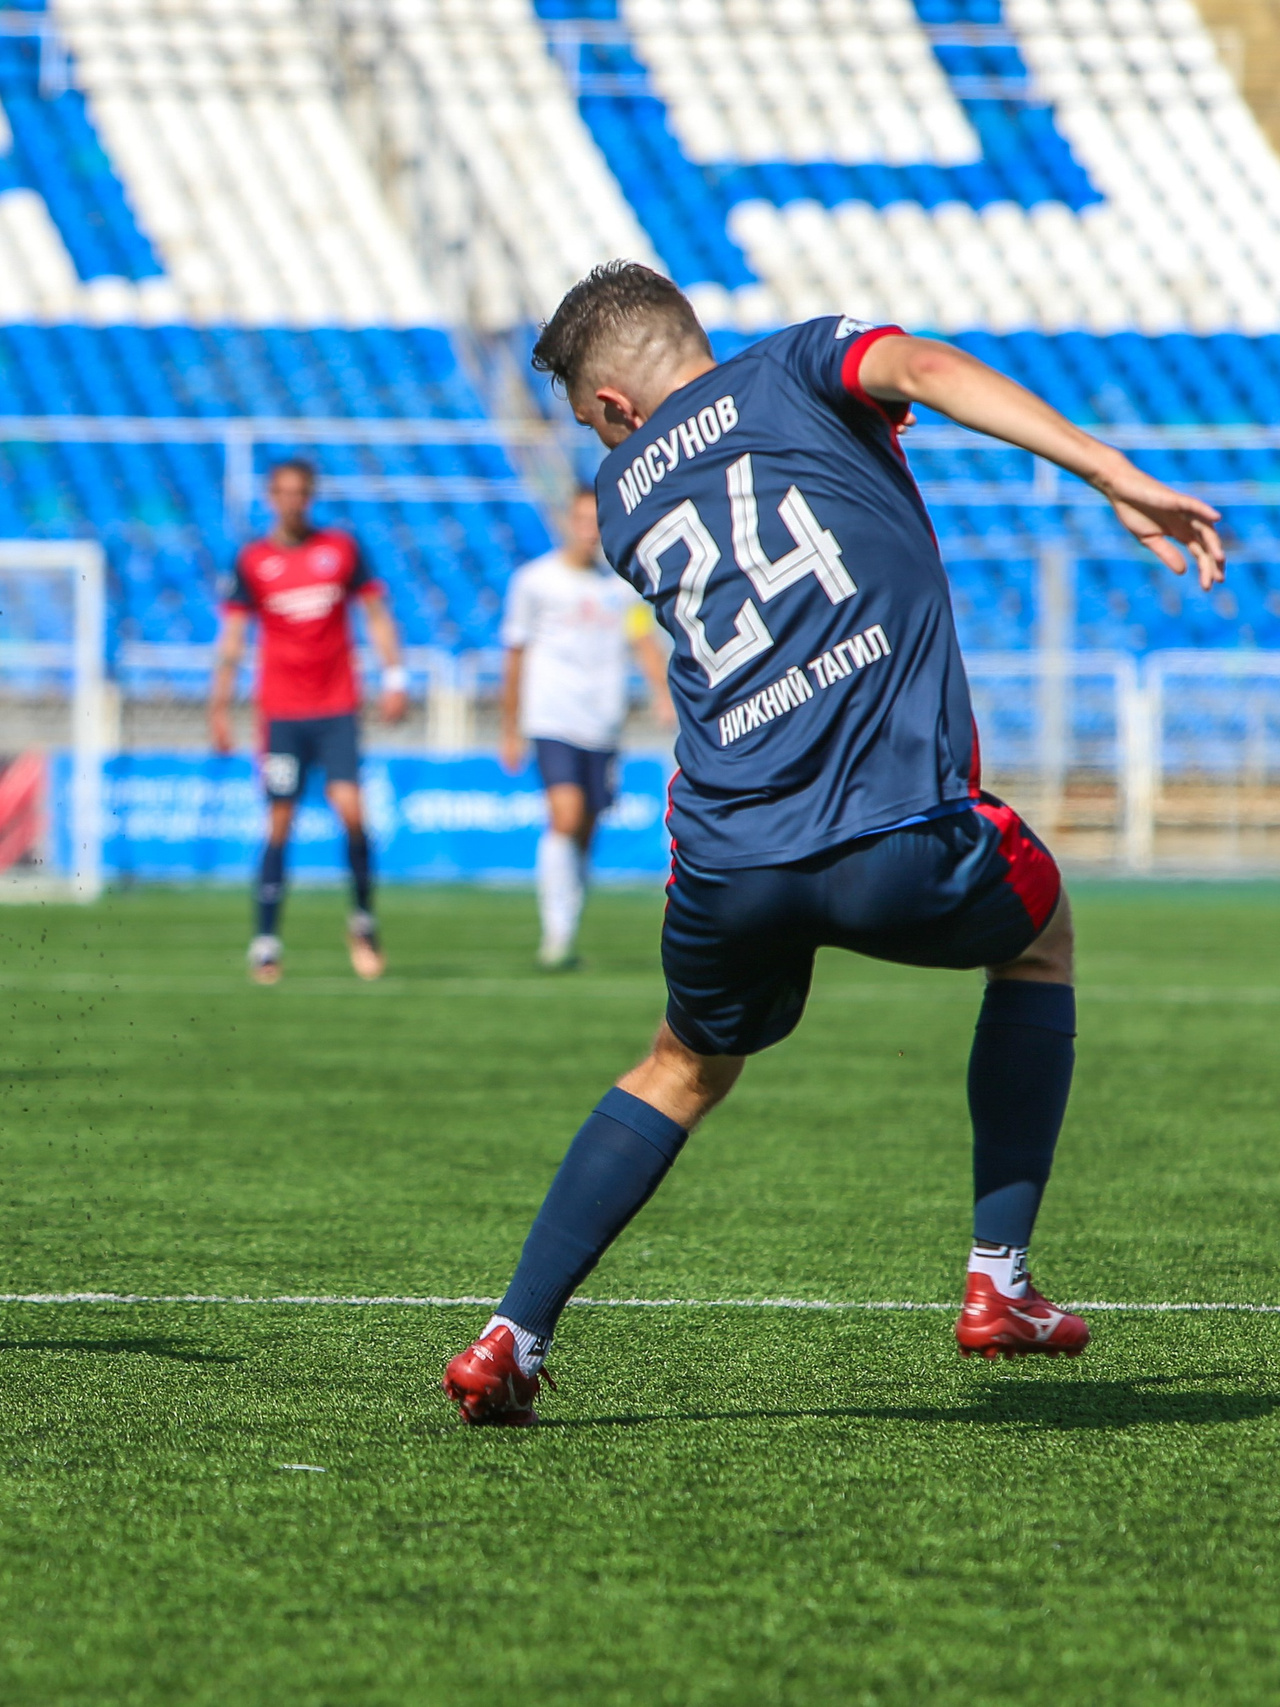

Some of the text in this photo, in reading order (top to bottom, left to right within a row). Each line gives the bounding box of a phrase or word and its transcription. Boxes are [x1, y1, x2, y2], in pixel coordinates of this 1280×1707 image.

[617, 395, 739, 515] МОСУНОВ
[635, 452, 858, 689] 24
[719, 624, 892, 747] НИЖНИЙ ТАГИЛ
